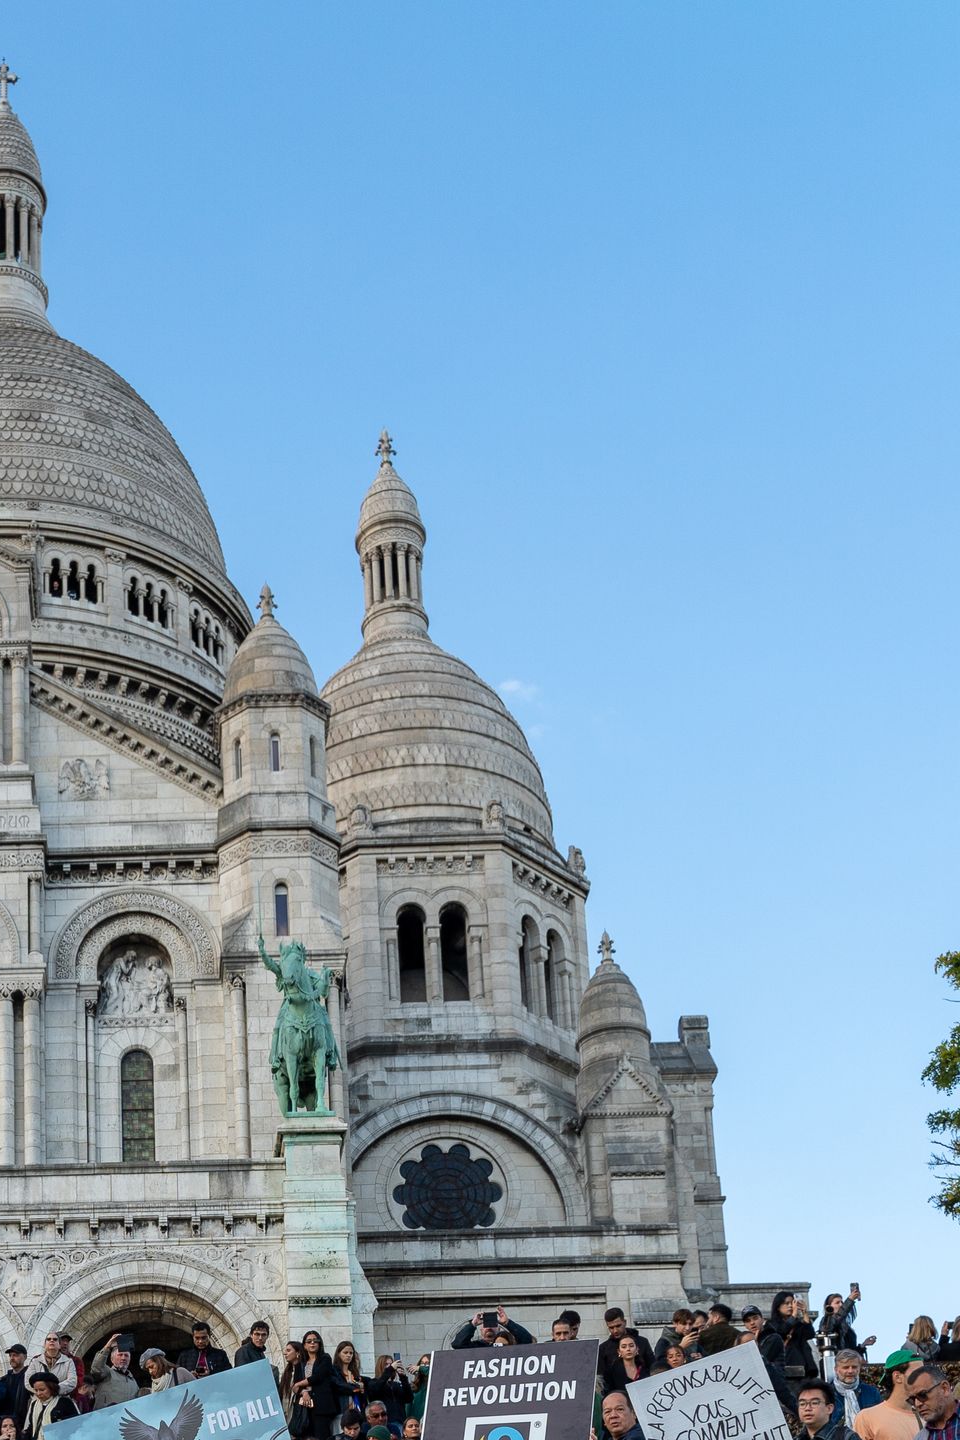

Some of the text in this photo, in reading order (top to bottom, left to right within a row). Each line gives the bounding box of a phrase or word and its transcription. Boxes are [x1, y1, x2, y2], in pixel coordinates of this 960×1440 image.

[463, 1354, 556, 1379] FASHION
[442, 1380, 577, 1407] REVOLUTION
[206, 1395, 279, 1434] FOR ALL
[679, 1398, 732, 1428] VOUS
